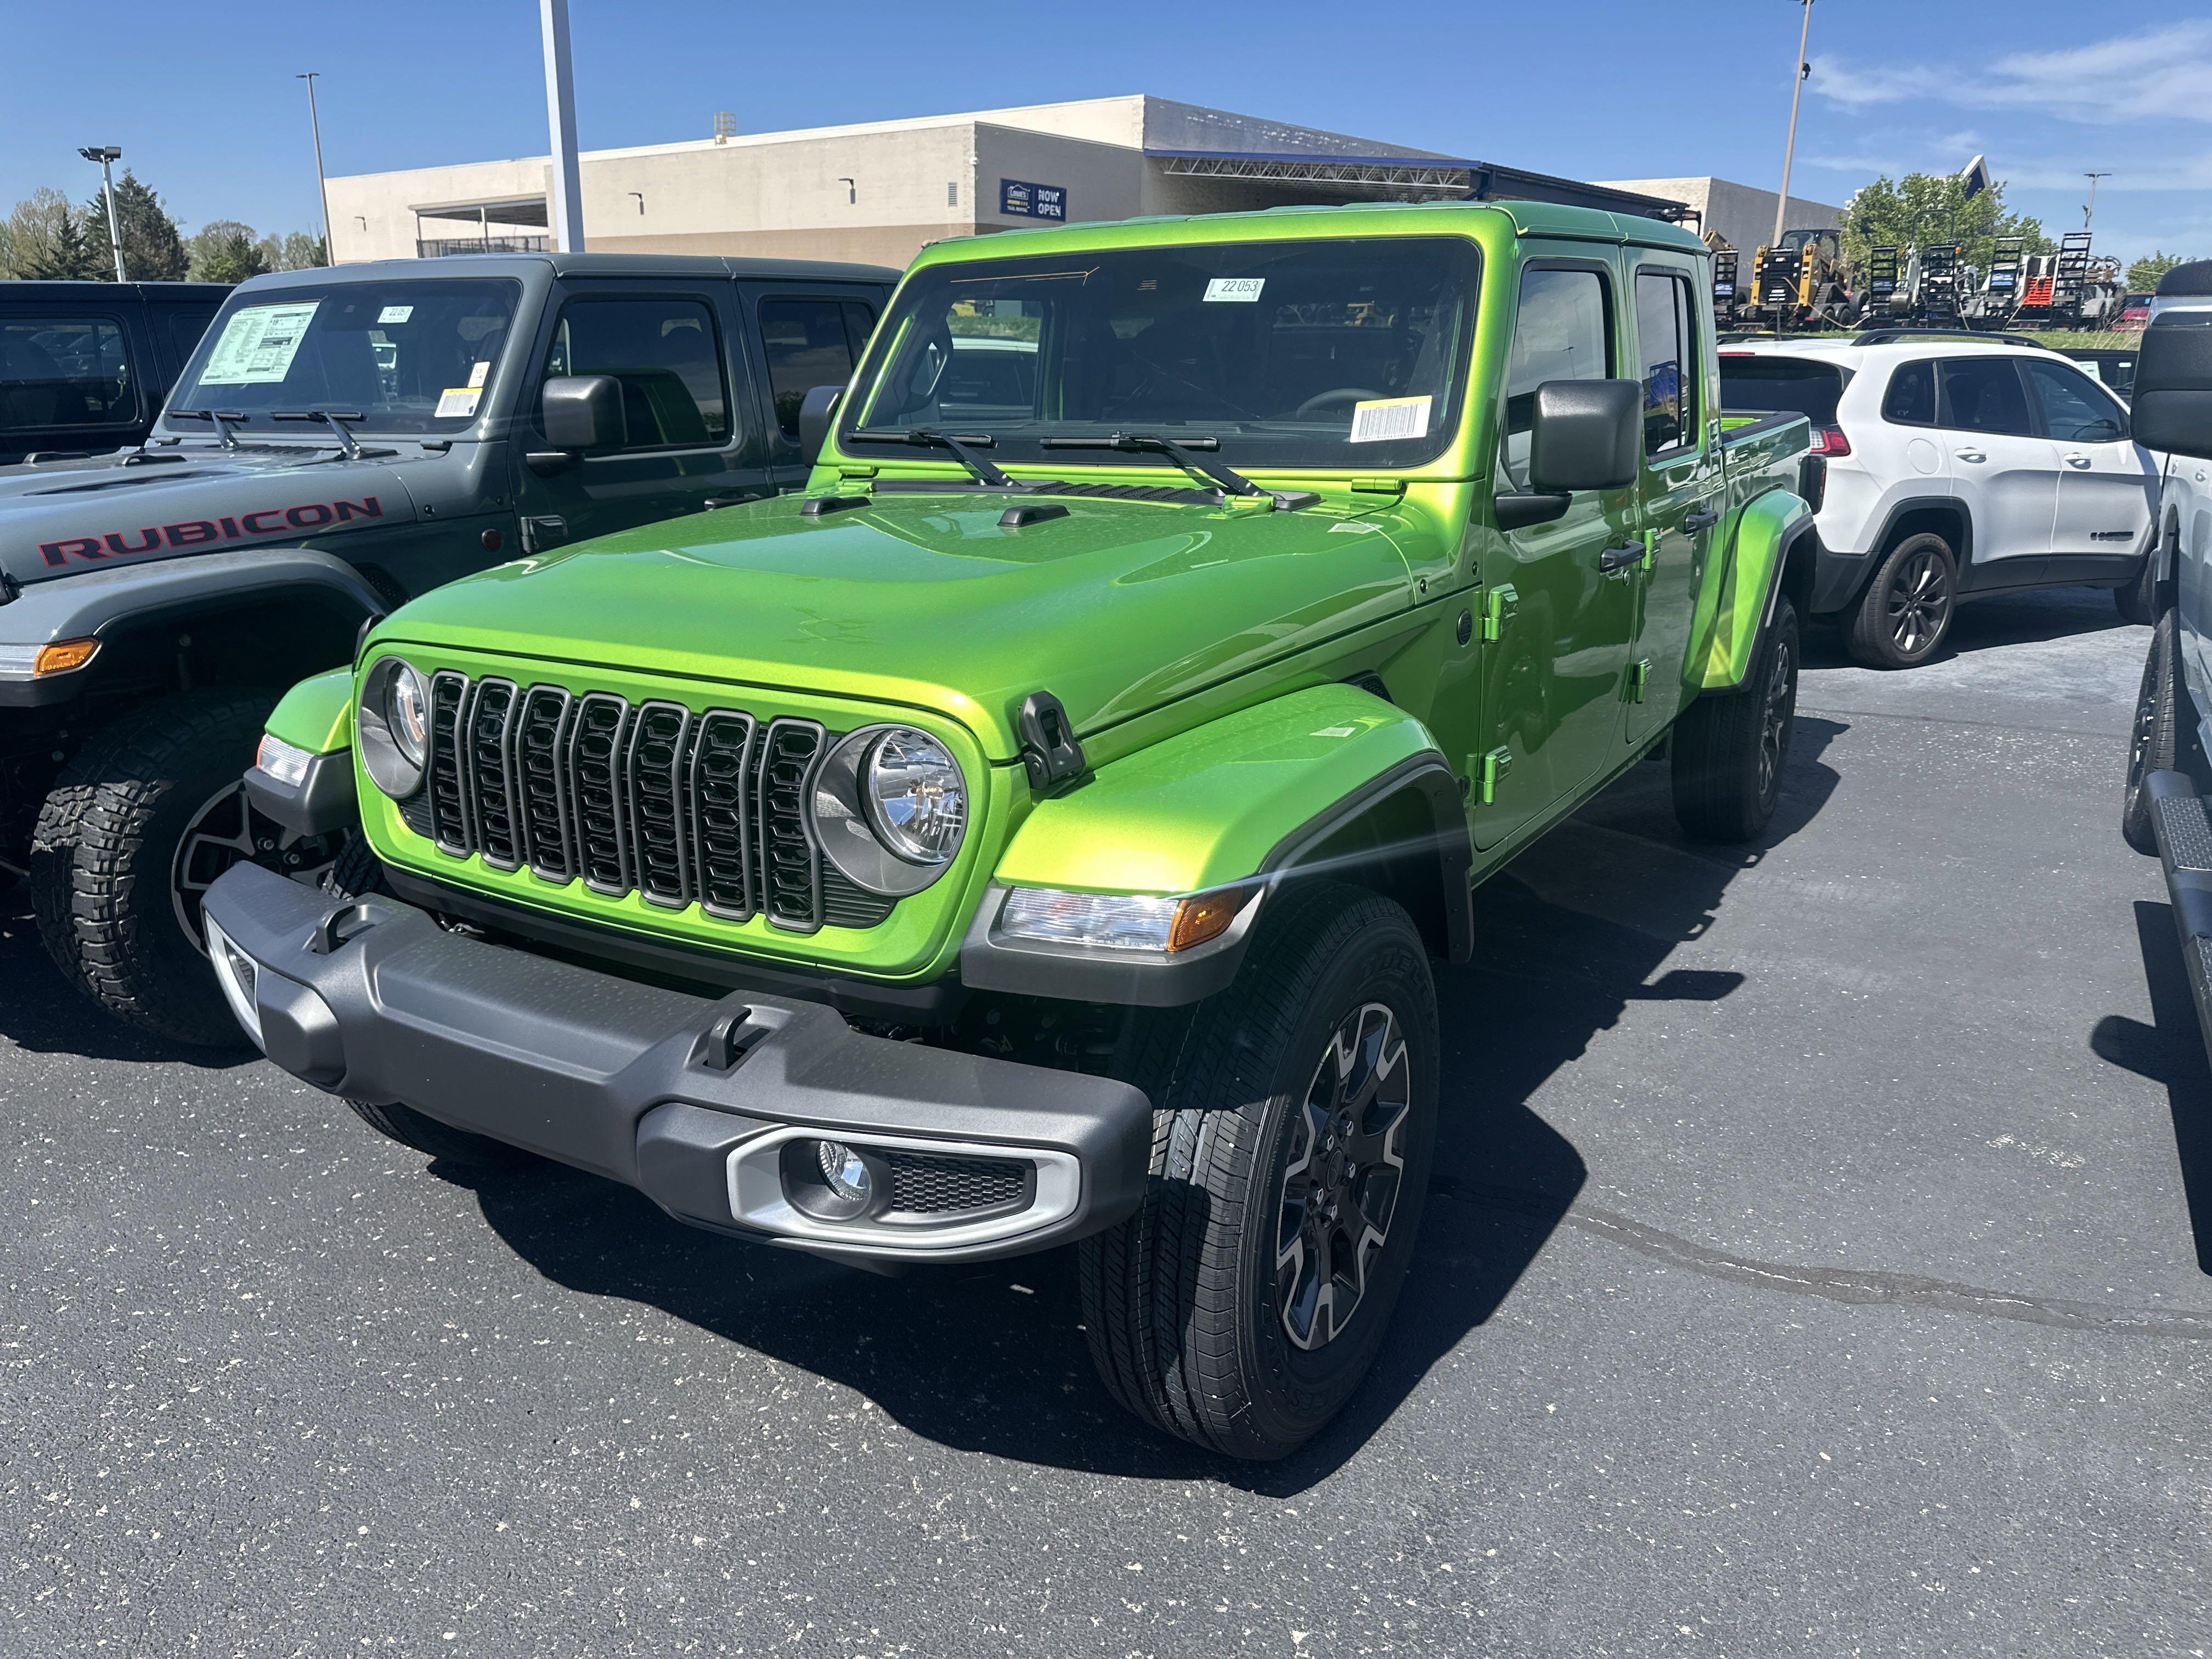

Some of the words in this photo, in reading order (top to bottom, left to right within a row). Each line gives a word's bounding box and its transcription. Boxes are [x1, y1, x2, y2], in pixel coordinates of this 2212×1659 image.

[1038, 189, 1060, 203] NOW
[1037, 203, 1061, 217] OPEN
[1221, 280, 1237, 292] 22
[1237, 280, 1259, 292] 053
[37, 496, 383, 568] RUBICON
